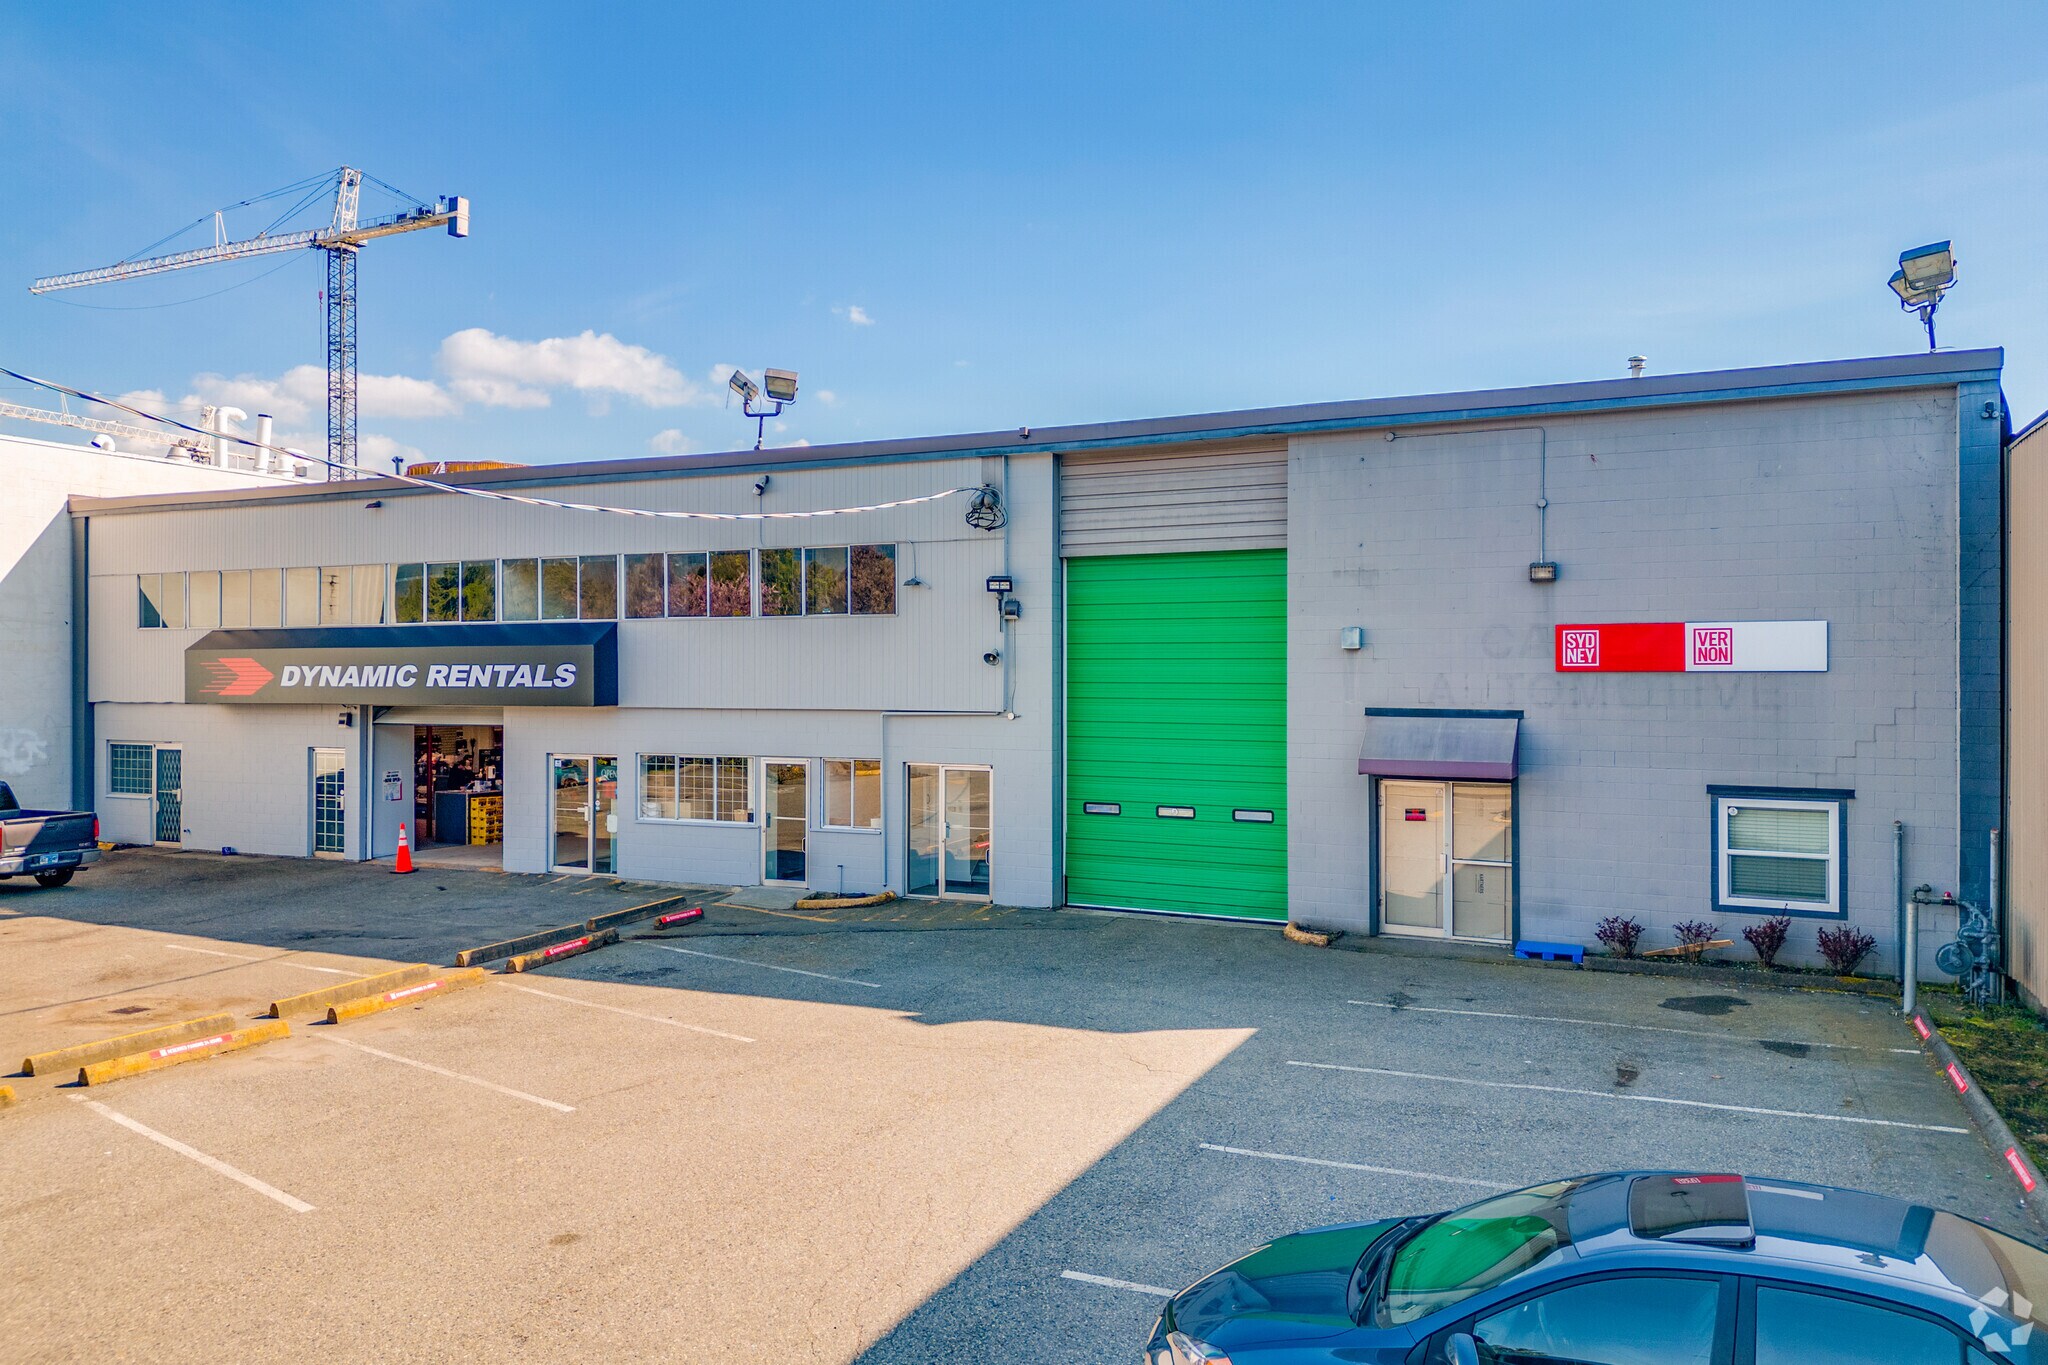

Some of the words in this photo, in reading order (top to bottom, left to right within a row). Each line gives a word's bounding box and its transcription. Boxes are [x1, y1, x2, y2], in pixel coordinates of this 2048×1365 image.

[1566, 633, 1595, 648] SYD
[1697, 631, 1728, 647] VER
[1566, 648, 1595, 663] NEY
[1697, 647, 1728, 662] NON
[280, 664, 418, 687] DYNAMIC
[426, 663, 576, 688] RENTALS
